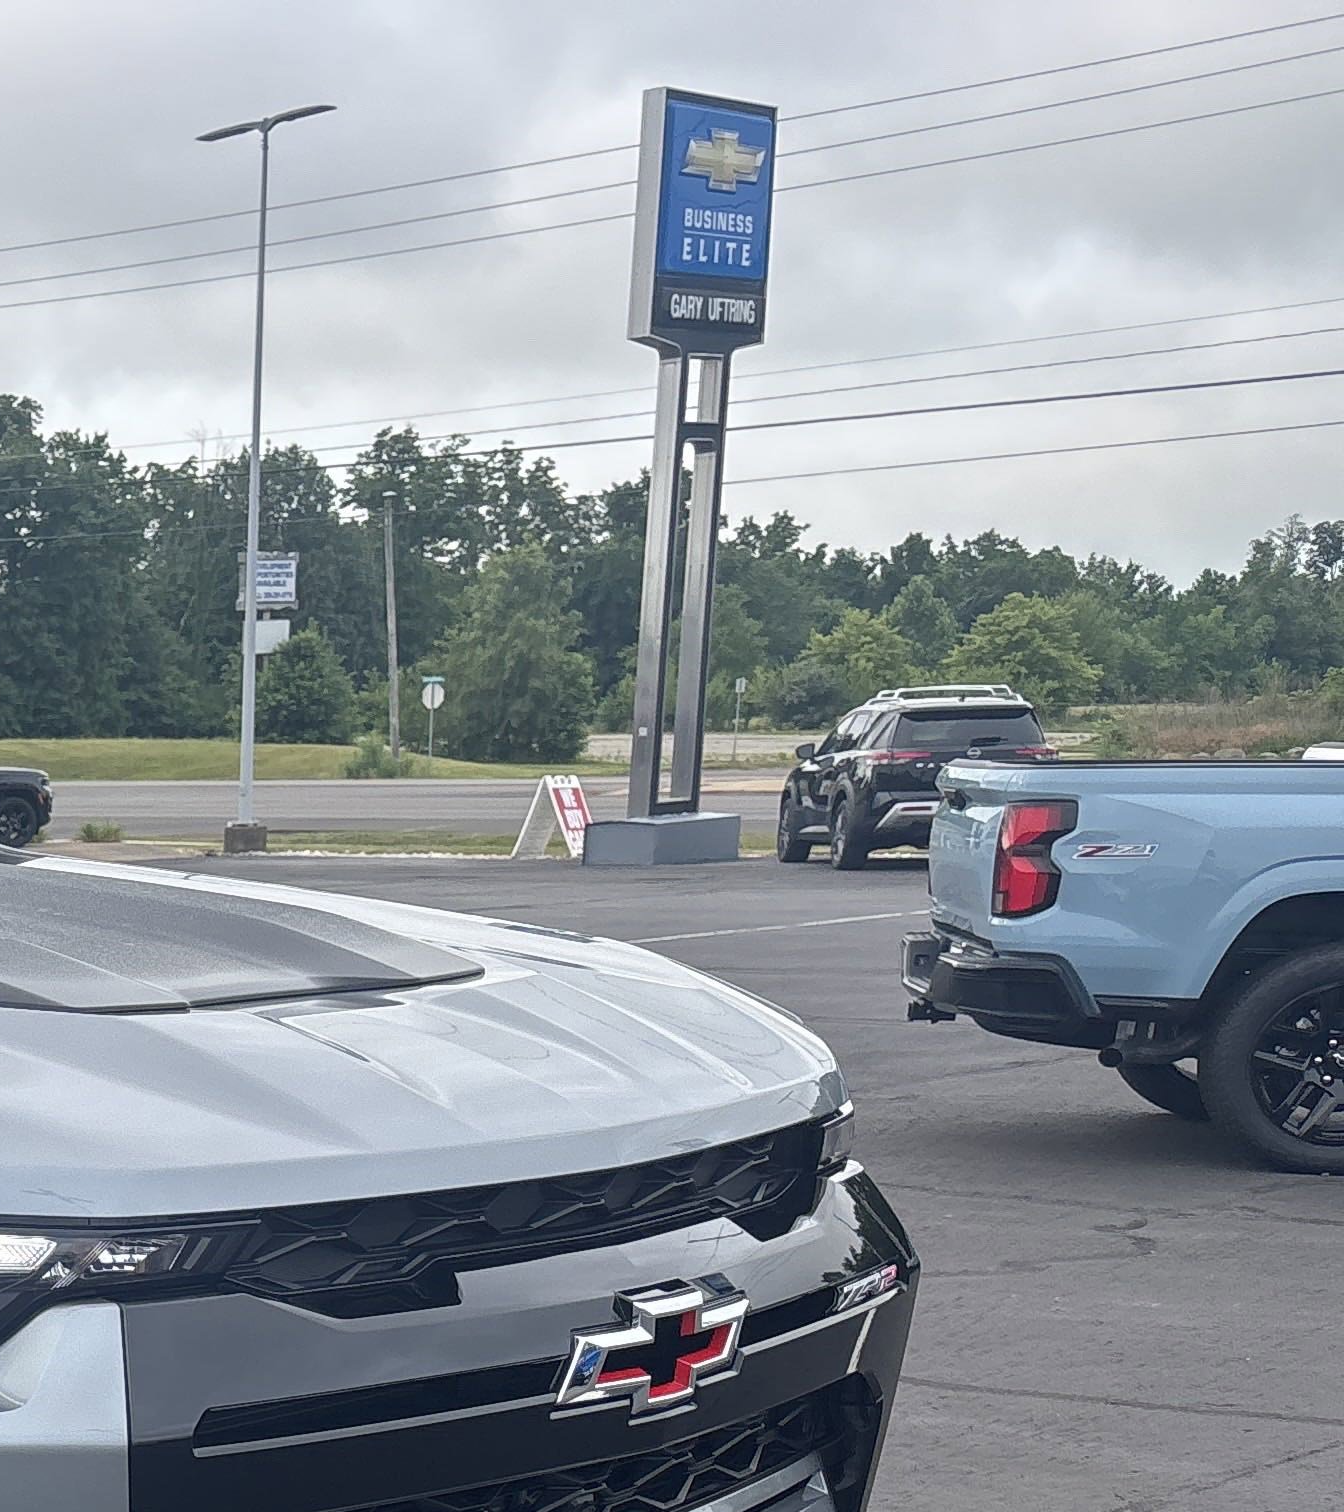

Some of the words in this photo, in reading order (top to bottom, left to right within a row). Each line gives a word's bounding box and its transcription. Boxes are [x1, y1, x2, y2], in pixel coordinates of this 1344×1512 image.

[684, 207, 754, 235] BUSINESS
[682, 238, 752, 267] ELITE
[670, 294, 703, 320] GARY
[707, 297, 756, 325] UFTRING
[1072, 843, 1160, 860] Z71
[838, 1264, 898, 1311] ZR2
